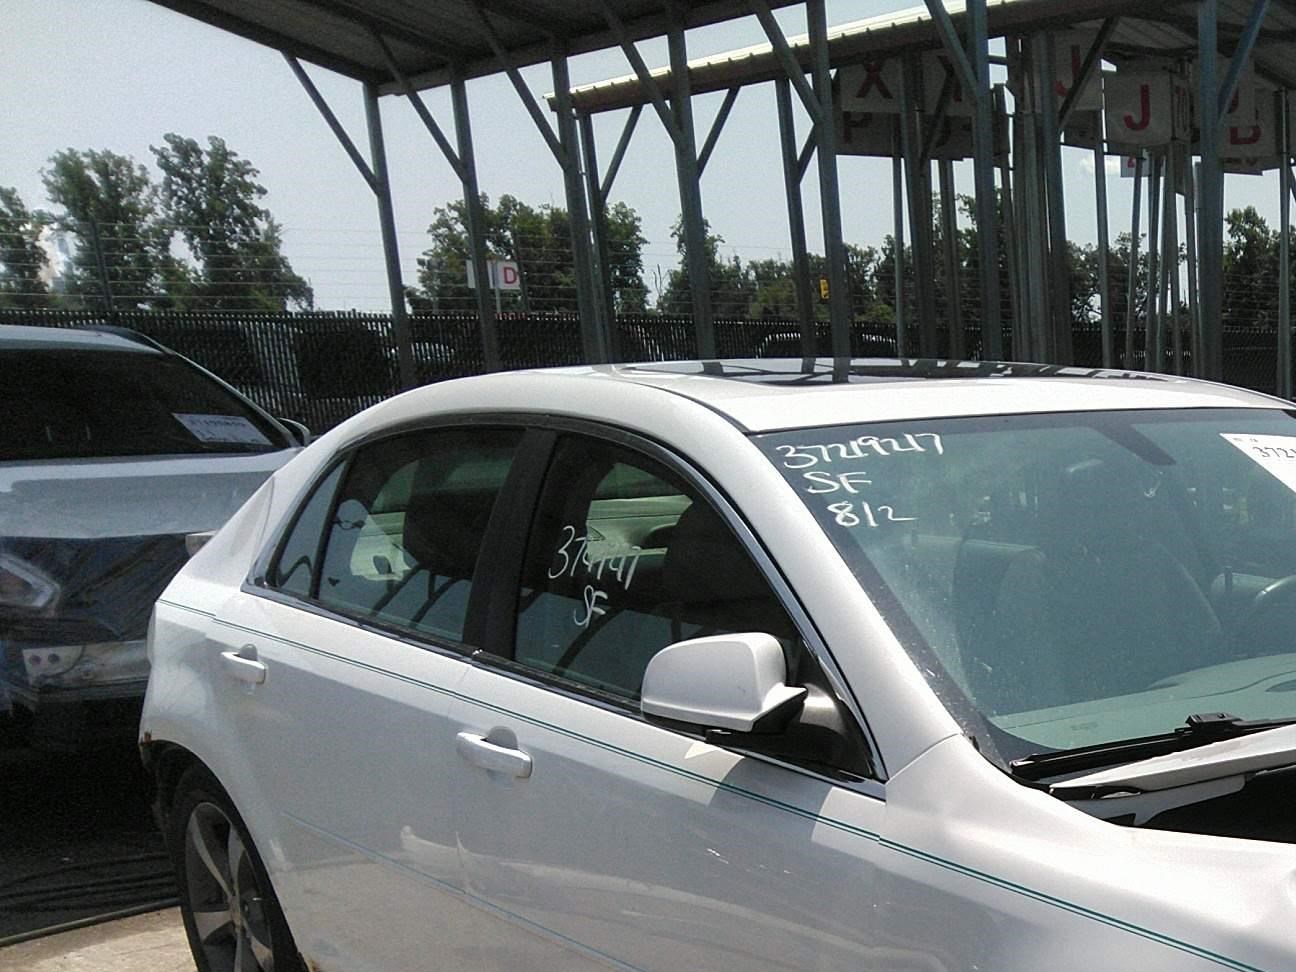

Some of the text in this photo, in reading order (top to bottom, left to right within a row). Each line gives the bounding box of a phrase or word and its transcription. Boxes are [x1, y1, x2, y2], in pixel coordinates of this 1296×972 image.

[1123, 84, 1151, 131] J
[503, 266, 517, 284] D
[776, 432, 944, 469] 37219217
[803, 471, 872, 494] SF
